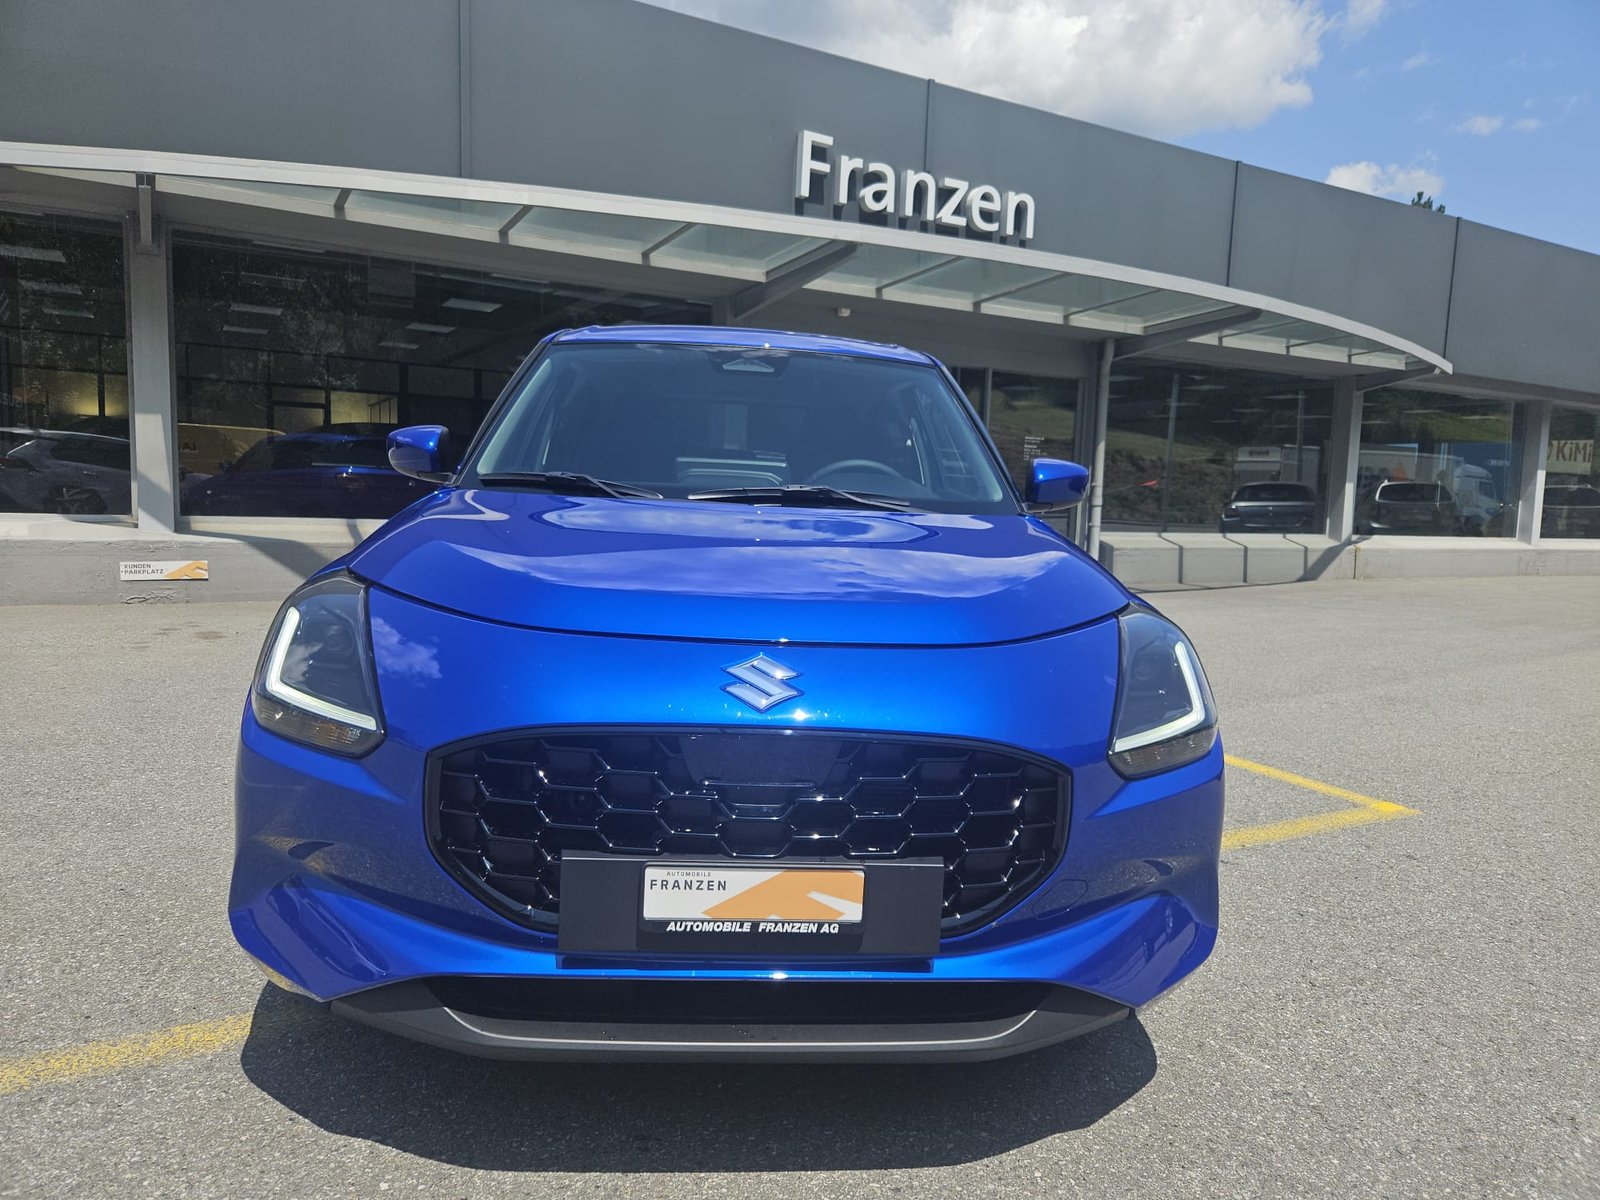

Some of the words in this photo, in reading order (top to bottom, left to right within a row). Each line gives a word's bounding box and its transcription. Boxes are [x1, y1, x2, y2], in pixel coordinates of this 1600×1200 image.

[795, 130, 1036, 239] Franzen
[650, 879, 727, 891] FRANZEN
[666, 921, 751, 932] AUTOMOBILE
[758, 922, 819, 933] FRANZEN
[820, 923, 839, 934] AG
